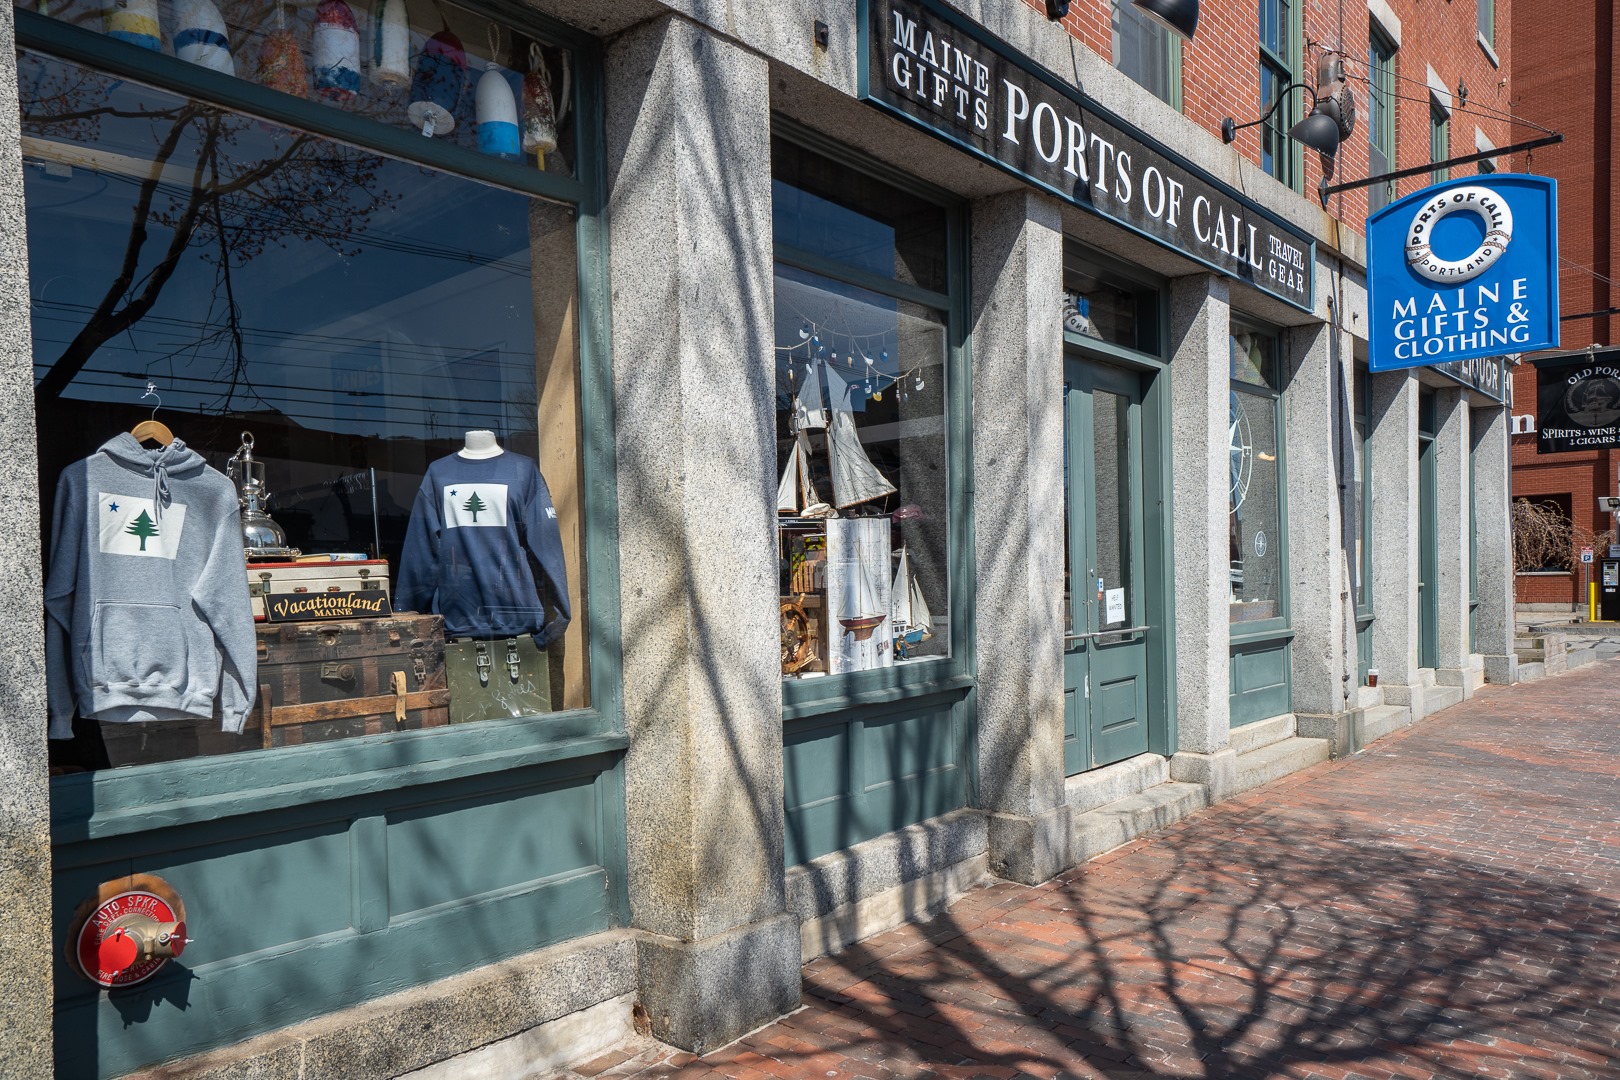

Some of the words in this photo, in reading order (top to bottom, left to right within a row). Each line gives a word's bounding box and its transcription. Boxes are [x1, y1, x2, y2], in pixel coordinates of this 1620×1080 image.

[893, 10, 990, 97] MAINE
[892, 52, 989, 131] GIFTS
[1002, 78, 1132, 204] PORTS
[1142, 166, 1184, 228] OF
[1192, 195, 1263, 270] CALL
[1411, 197, 1446, 245] PORTS
[1453, 192, 1476, 203] OF
[1479, 196, 1503, 229] CALL
[1269, 234, 1305, 271] TRAVEL
[1421, 248, 1492, 276] PORTLAND
[1268, 259, 1304, 293] GEAR
[1392, 278, 1527, 320] MAINE
[1394, 307, 1489, 341] GIFTS
[1506, 302, 1530, 324] &
[1394, 324, 1530, 359] CLOTHING
[1567, 368, 1592, 385] OLD
[1594, 366, 1620, 380] POR
[1542, 427, 1581, 439] SPIRITS
[1588, 426, 1616, 436] WINE
[1576, 435, 1616, 445] CIGARS
[273, 592, 386, 617] Vacationland
[313, 608, 353, 617] MAINE
[127, 895, 159, 912] SPKR.
[96, 969, 113, 981] FIRE
[114, 973, 132, 982] HOSE
